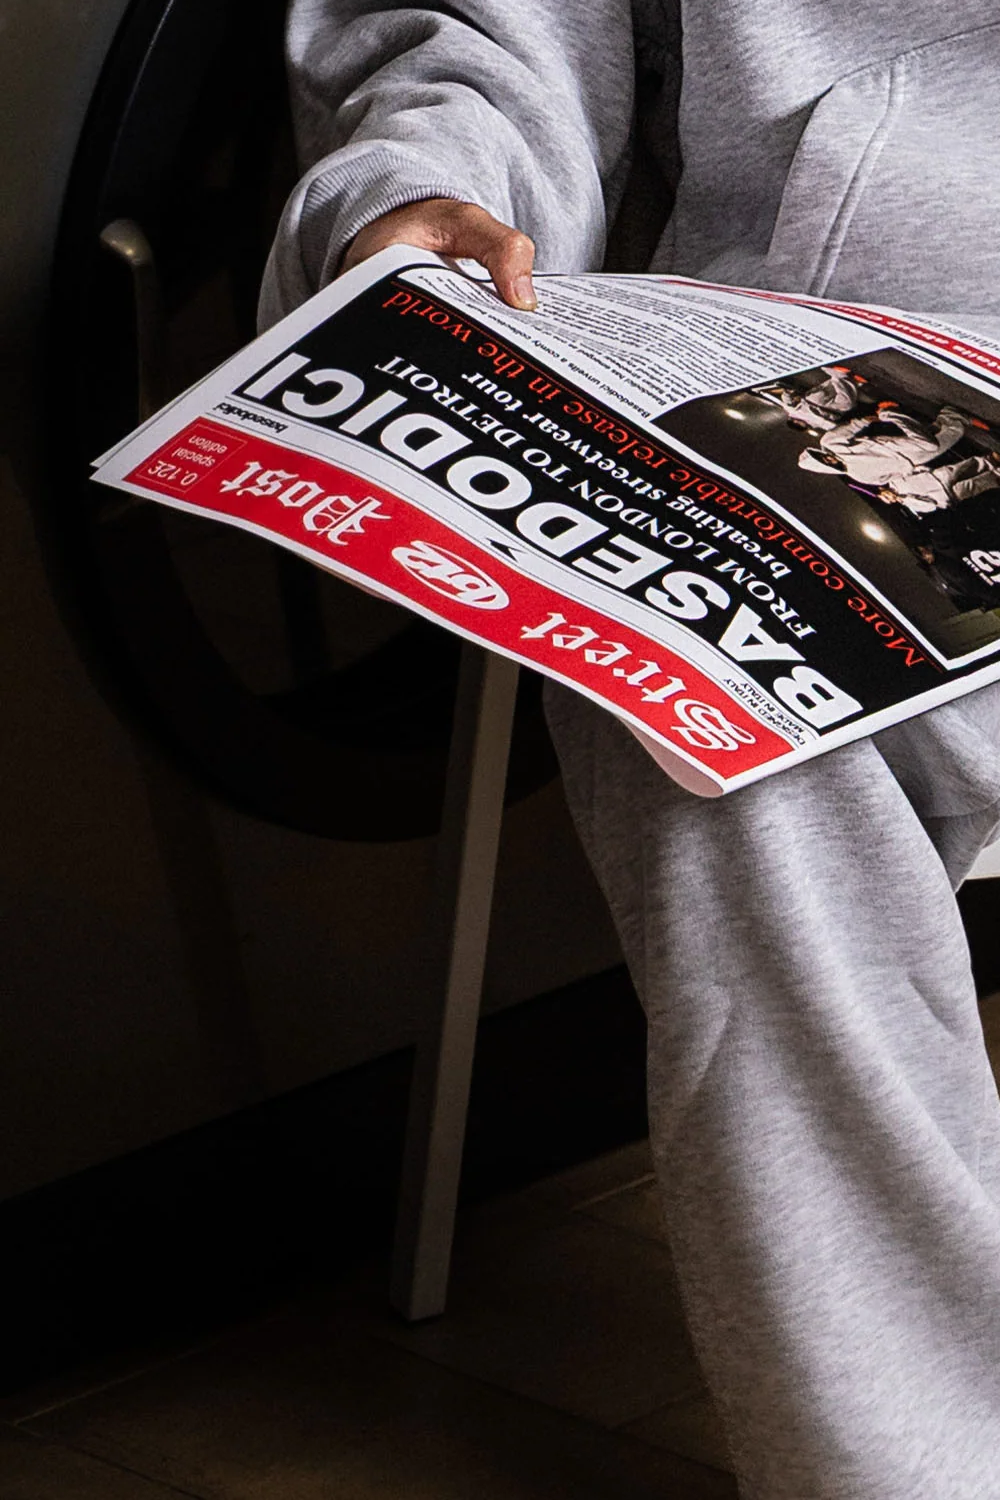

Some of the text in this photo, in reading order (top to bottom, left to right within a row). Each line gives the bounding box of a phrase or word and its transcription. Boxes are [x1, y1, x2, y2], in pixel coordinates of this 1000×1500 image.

[383, 292, 471, 341] world
[478, 343, 524, 377] the
[529, 377, 560, 402] in
[173, 446, 217, 468] special
[188, 434, 228, 455] edition
[564, 402, 667, 468] release
[149, 461, 197, 485] 0.12£
[220, 462, 391, 545] Post
[375, 357, 815, 638] FROM LONDON TO DETROIT
[462, 373, 791, 579] breaking streetwear tour
[244, 353, 863, 729] BASEDODICI
[670, 470, 844, 590] comfortable
[848, 597, 924, 666] More
[521, 613, 756, 750] Street
[723, 678, 749, 699] ITALY
